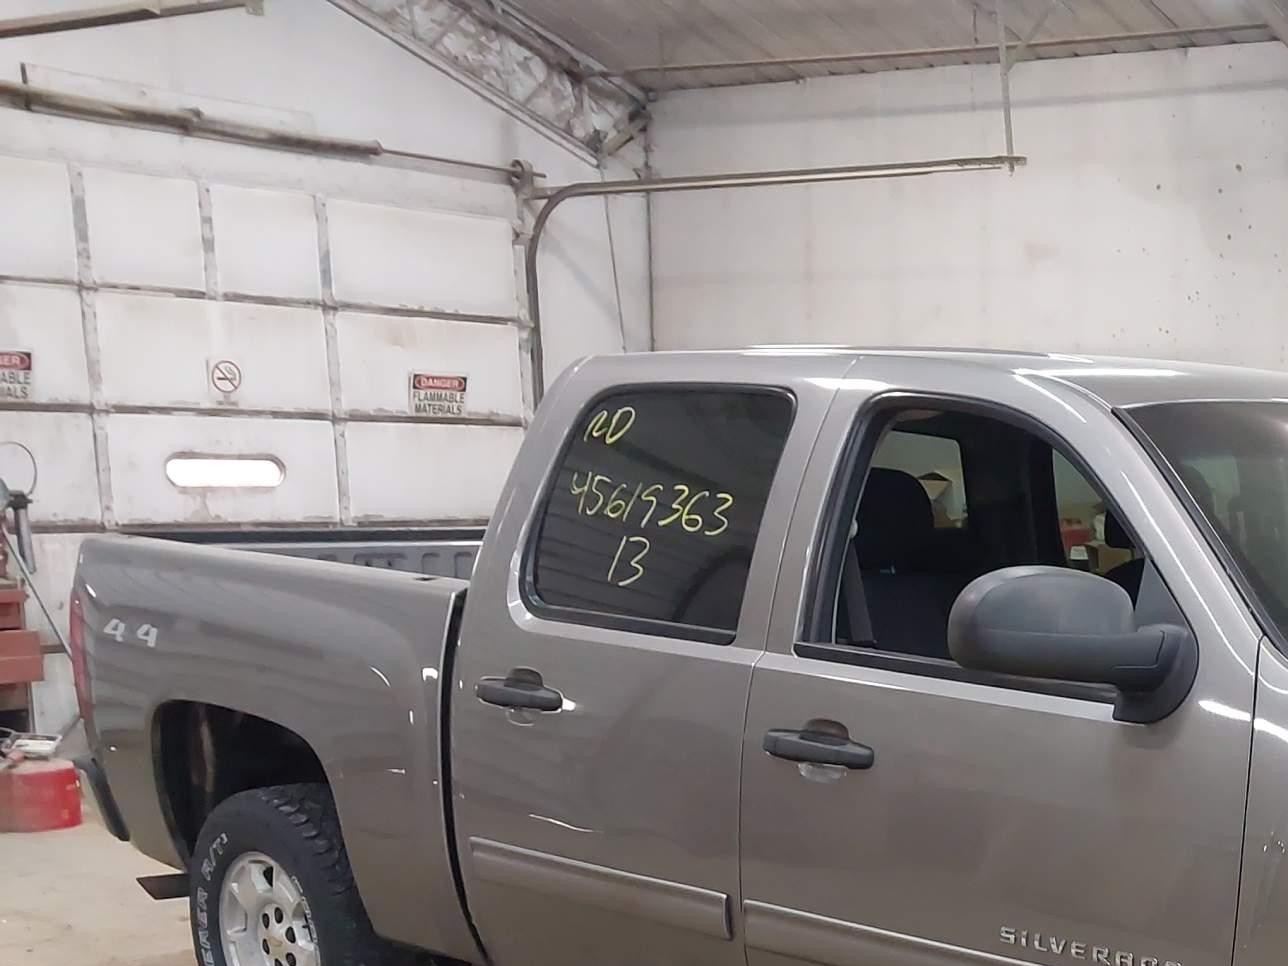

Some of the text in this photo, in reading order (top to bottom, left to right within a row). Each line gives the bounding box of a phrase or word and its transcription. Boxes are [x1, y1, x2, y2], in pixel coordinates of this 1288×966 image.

[420, 377, 459, 388] DANGER
[413, 391, 465, 404] FLAMMABLE
[414, 403, 463, 415] MATERIALS
[571, 472, 734, 536] 45619363
[607, 535, 651, 587] 13
